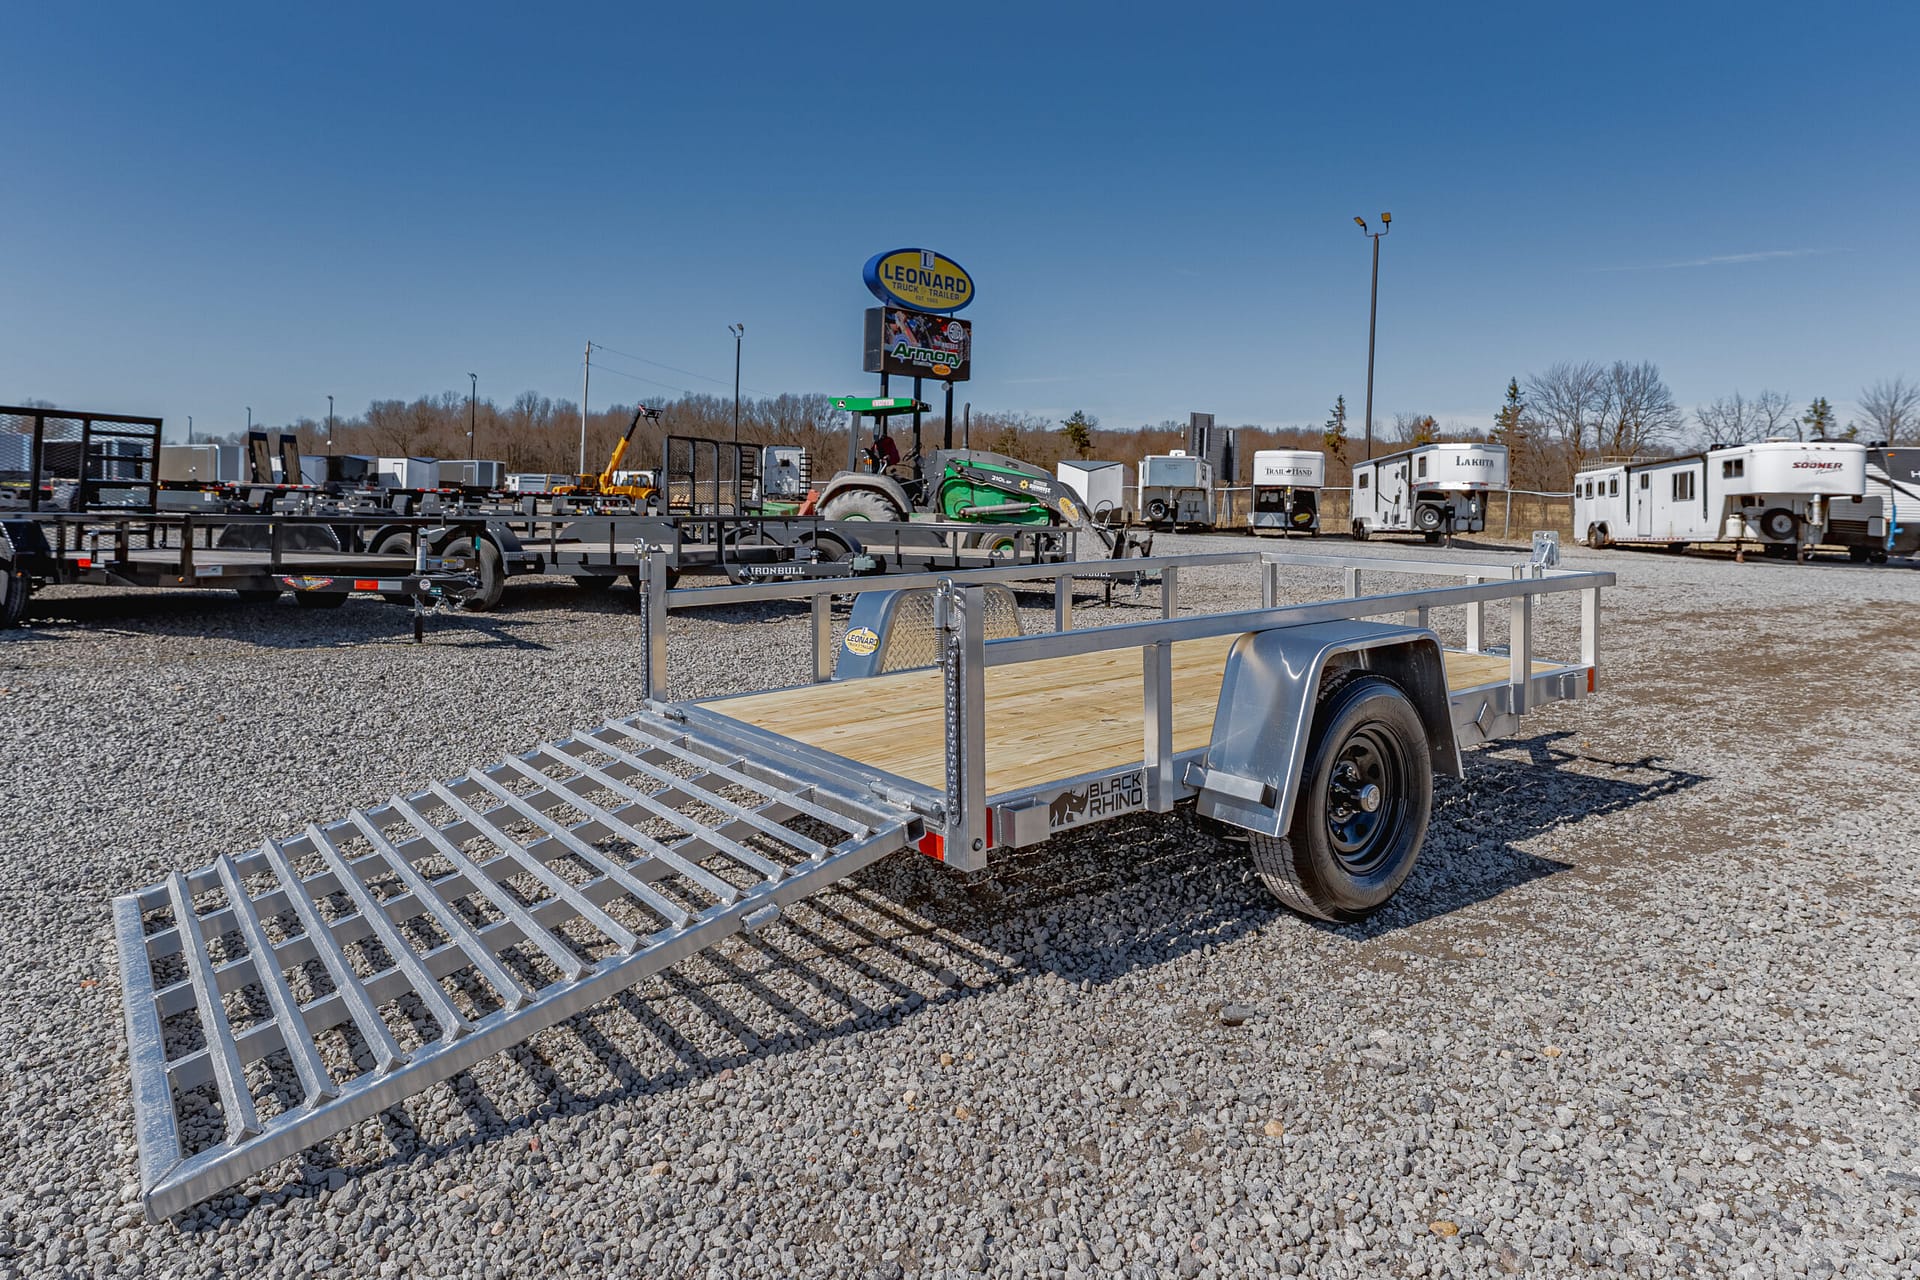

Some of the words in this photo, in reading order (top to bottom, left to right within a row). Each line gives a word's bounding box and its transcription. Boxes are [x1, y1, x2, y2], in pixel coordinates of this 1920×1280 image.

[884, 263, 967, 294] LEONARD
[892, 282, 919, 293] TRUCK
[929, 288, 960, 301] TRAILER
[891, 342, 962, 369] Armory
[1792, 461, 1843, 469] SOONER
[751, 566, 806, 575] IRONBULL
[1089, 772, 1142, 798] BLACK
[1089, 787, 1143, 817] RHINO
